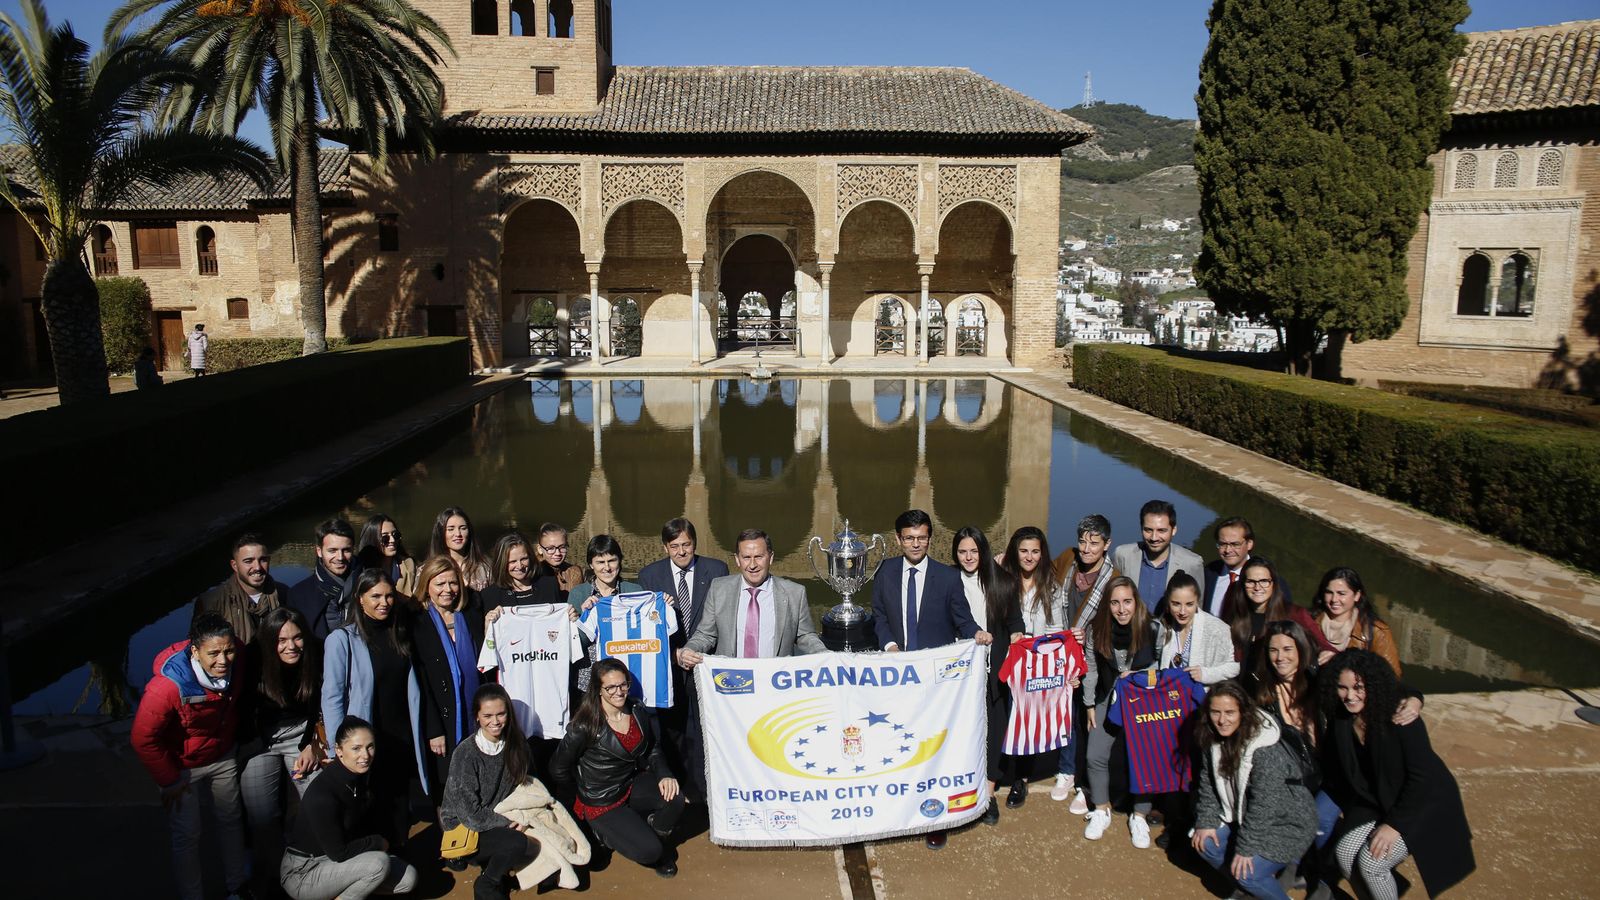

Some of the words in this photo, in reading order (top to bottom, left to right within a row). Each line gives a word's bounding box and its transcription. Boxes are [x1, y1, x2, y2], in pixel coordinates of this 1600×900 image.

[609, 641, 648, 653] euskaltel
[511, 648, 558, 664] Playtika
[945, 659, 971, 671] aces
[771, 665, 921, 690] GRANADA
[1135, 708, 1181, 724] STANLEY
[728, 788, 828, 802] EUROPEAN
[835, 784, 879, 800] CITY
[886, 783, 909, 796] OF
[916, 772, 975, 793] SPORT
[831, 805, 874, 820] 2019
